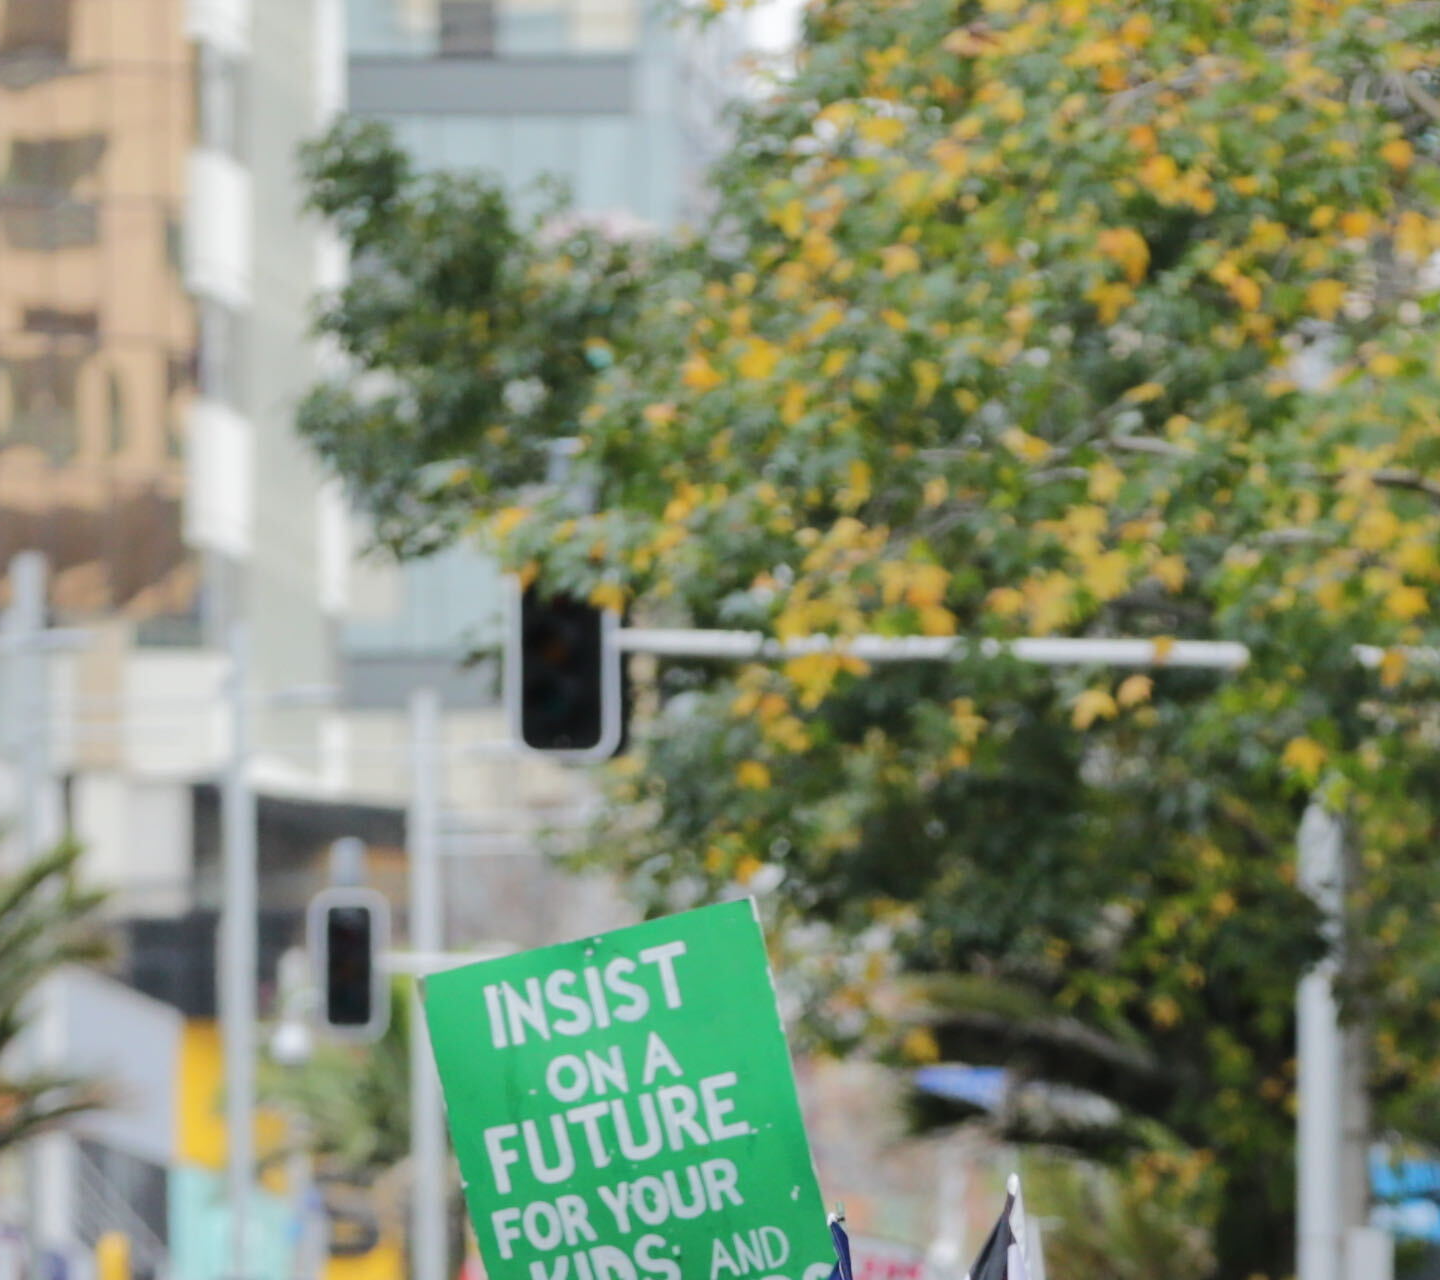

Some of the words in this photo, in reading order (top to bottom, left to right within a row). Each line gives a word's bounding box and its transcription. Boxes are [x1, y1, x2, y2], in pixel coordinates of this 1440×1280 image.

[482, 939, 688, 1049] INSIST
[545, 1045, 630, 1102] ON
[642, 1030, 683, 1085] A
[482, 1071, 751, 1195] FUTURE
[490, 1194, 598, 1260] FOR
[597, 1157, 745, 1235] YOUR
